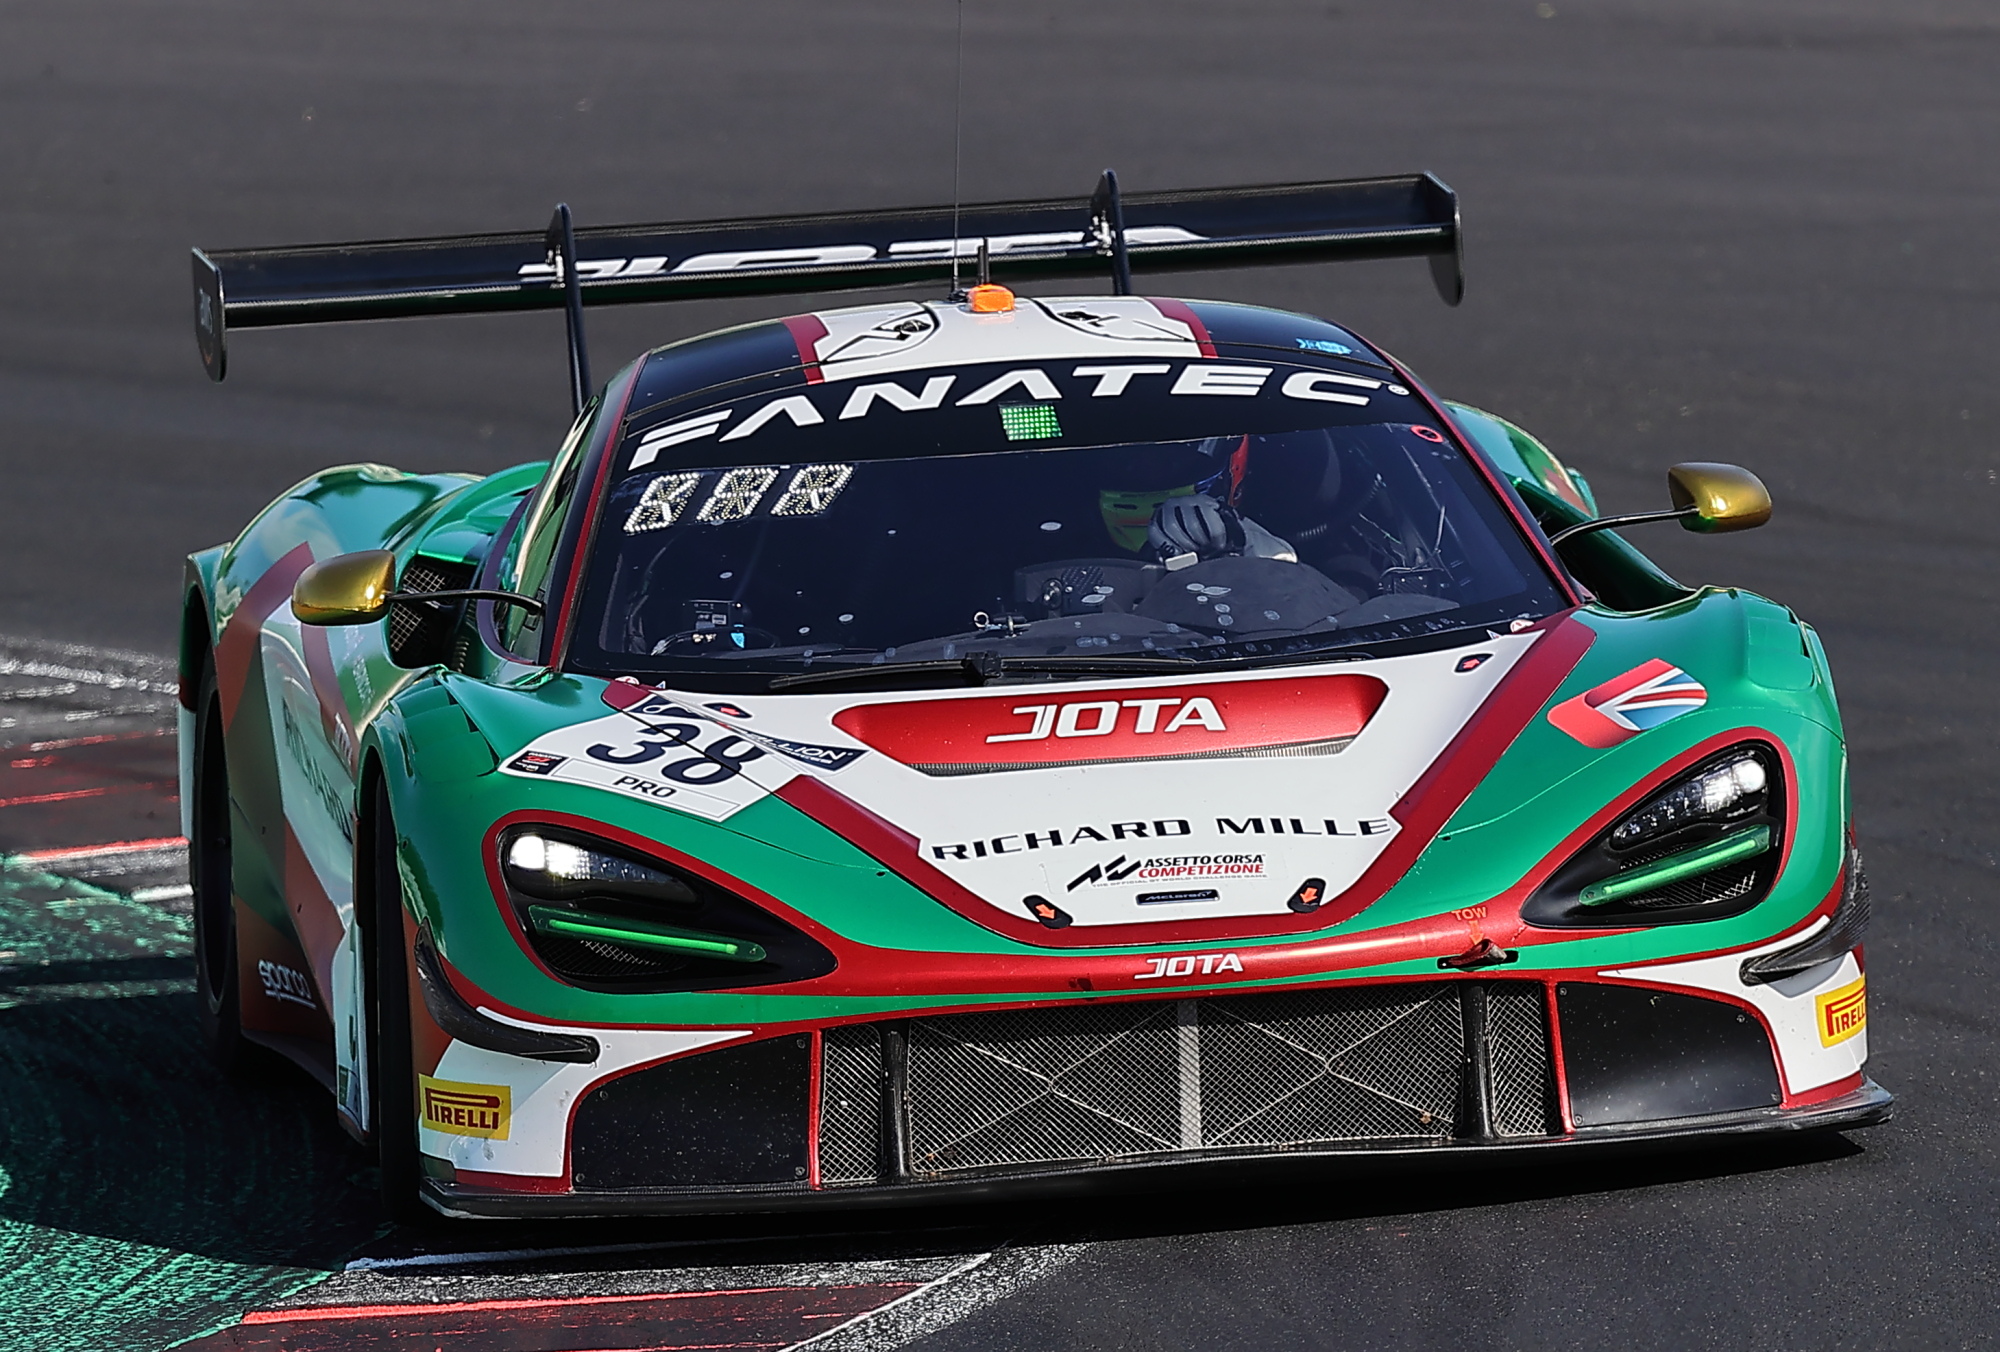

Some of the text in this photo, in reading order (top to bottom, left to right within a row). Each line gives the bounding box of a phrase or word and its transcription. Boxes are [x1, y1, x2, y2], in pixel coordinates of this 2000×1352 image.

[628, 362, 1382, 471] FANATEC
[985, 697, 1227, 743] JOTA
[586, 722, 765, 786] 38
[613, 775, 678, 799] PRO
[931, 817, 1392, 860] RICHARD MILLE
[1138, 863, 1264, 879] COMPETIZIONE
[1144, 854, 1264, 868] ASSETTO CORSA
[1451, 906, 1487, 921] TOW
[258, 958, 313, 1002] sparco
[1134, 953, 1244, 980] JOTA
[425, 1087, 501, 1130] PIRELLI
